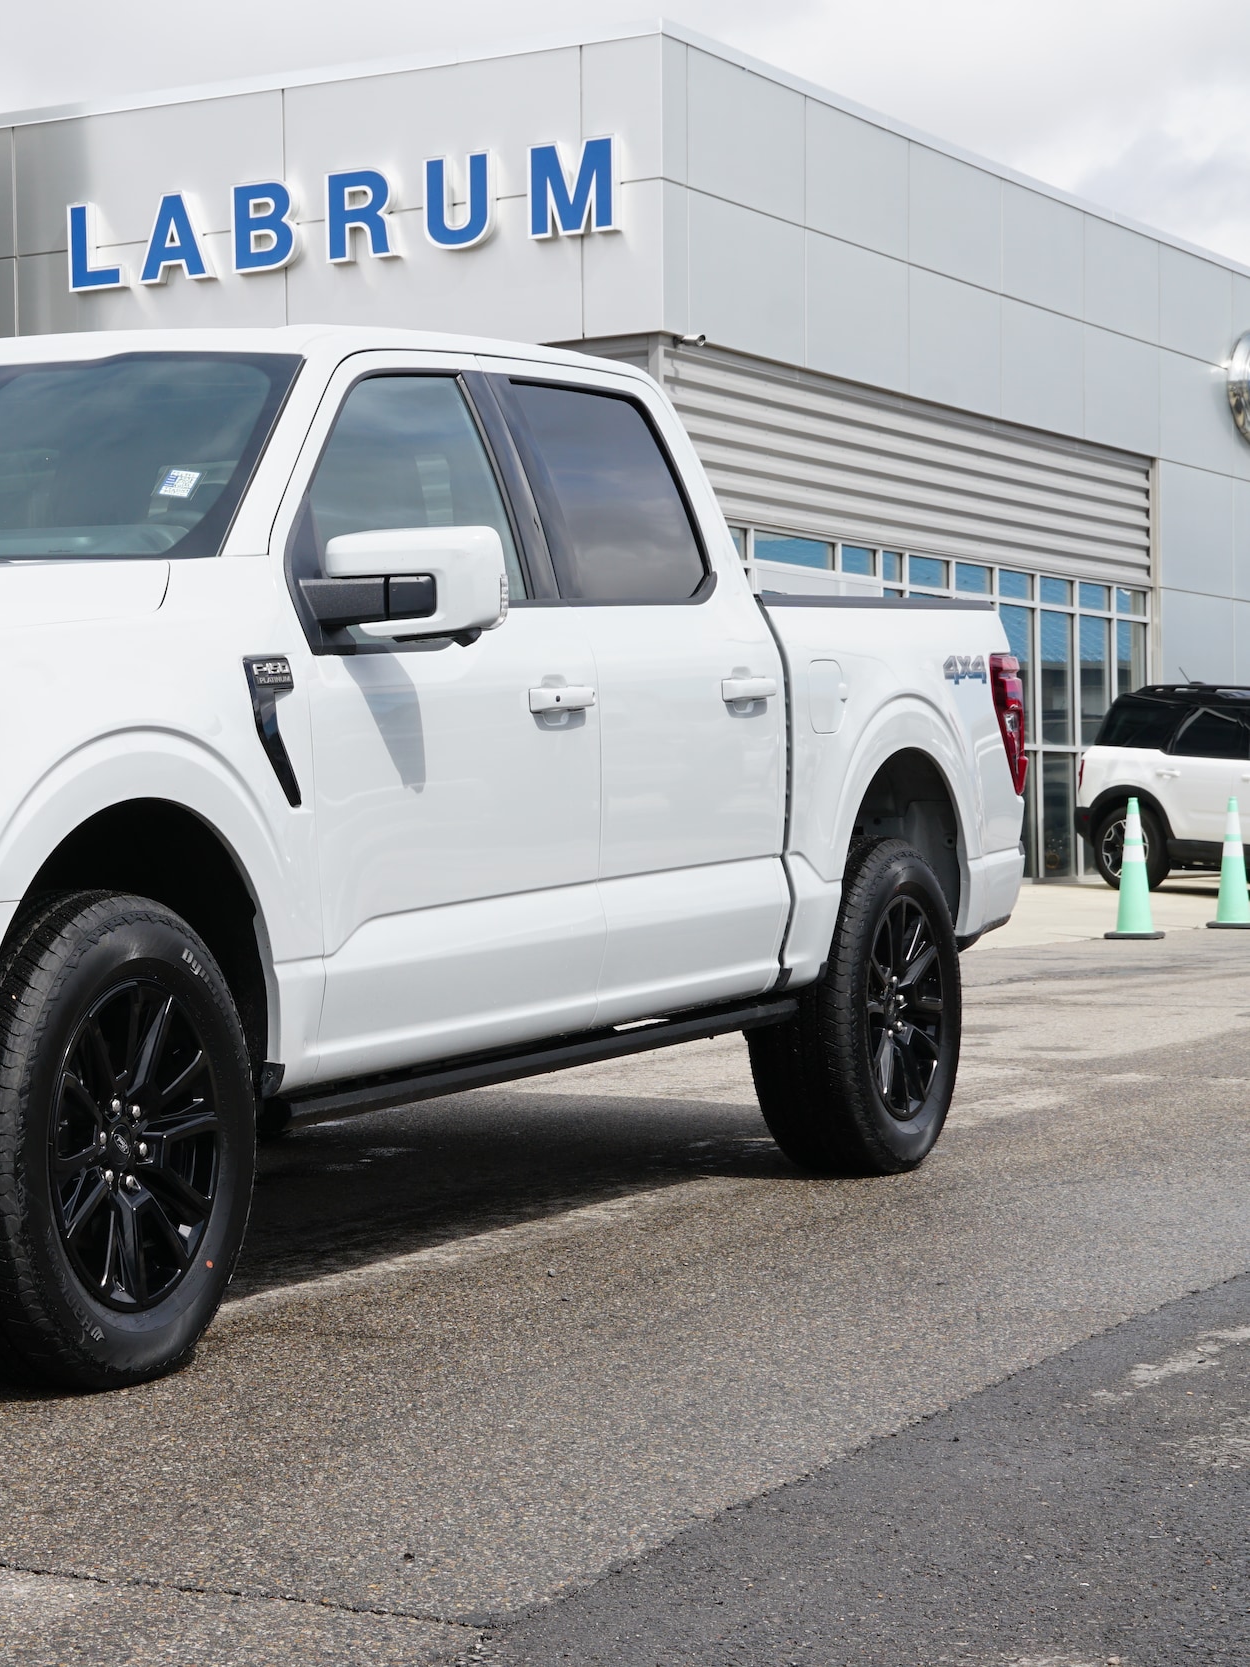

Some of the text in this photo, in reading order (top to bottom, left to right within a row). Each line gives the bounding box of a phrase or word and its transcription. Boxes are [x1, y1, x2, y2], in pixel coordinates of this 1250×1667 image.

[67, 134, 619, 293] LABRUM
[252, 662, 290, 676] F-150
[259, 676, 291, 684] PLATINUM
